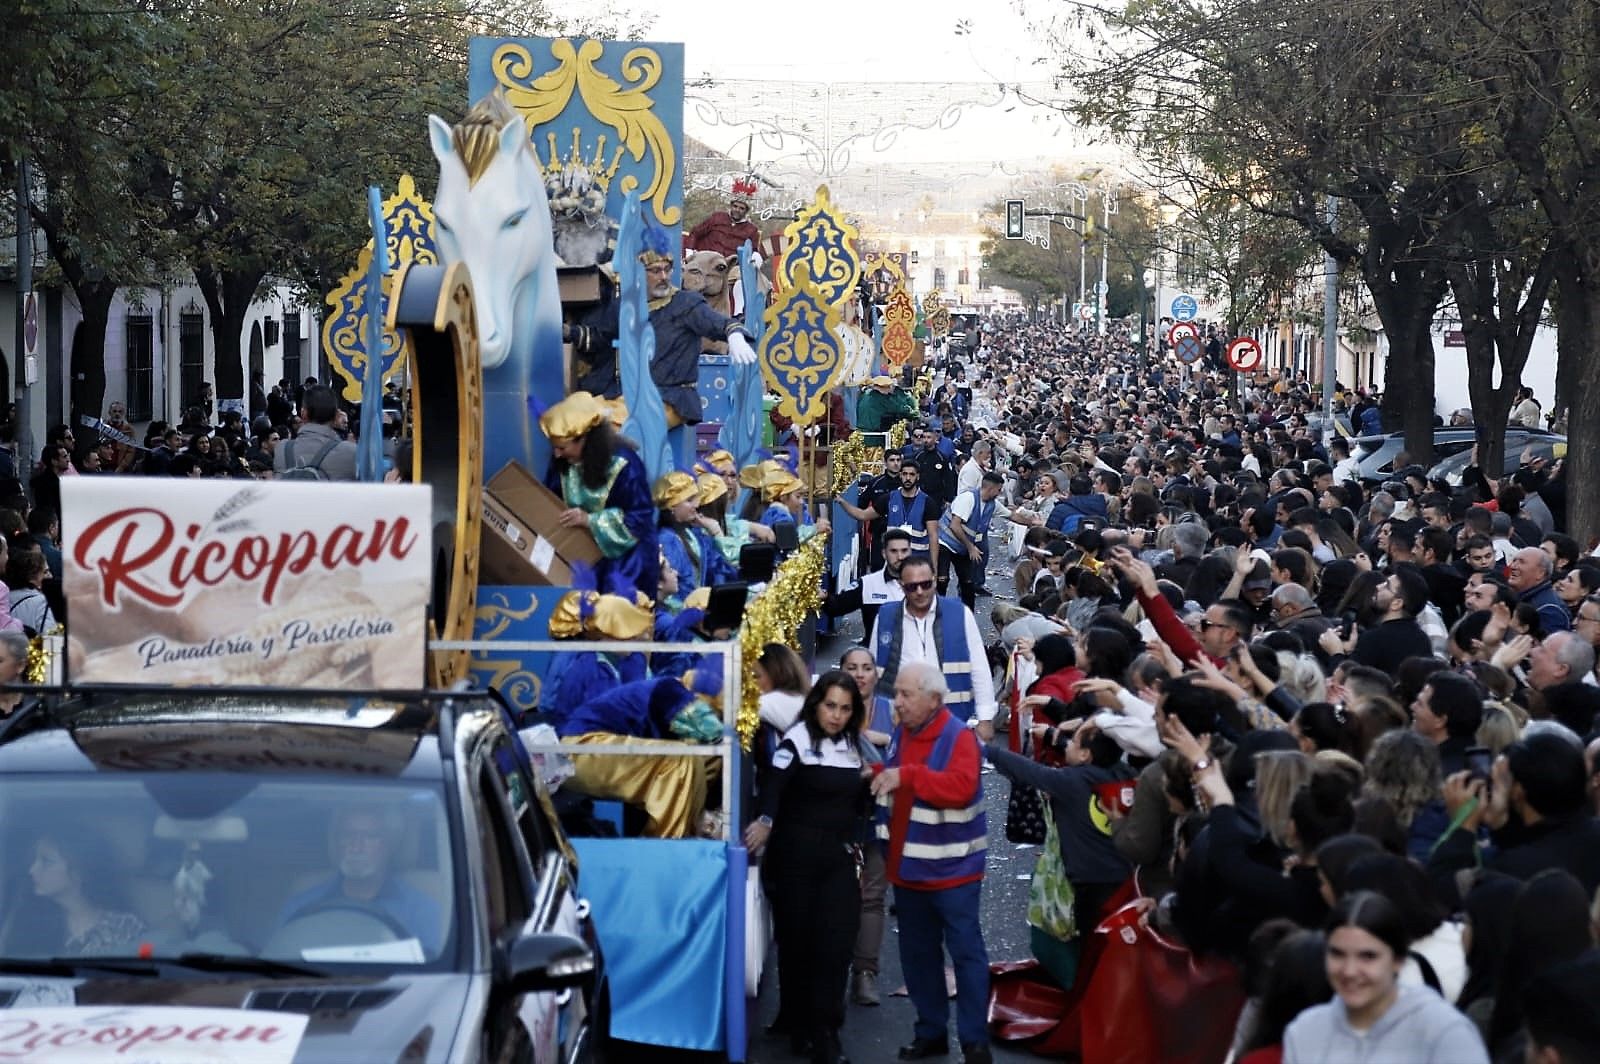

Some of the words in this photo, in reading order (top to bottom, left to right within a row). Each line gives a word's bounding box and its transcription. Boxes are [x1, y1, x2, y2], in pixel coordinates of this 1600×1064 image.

[74, 507, 417, 607] Ricopan
[138, 635, 253, 668] Panadería
[262, 637, 274, 660] y
[283, 617, 394, 650] Pastelería
